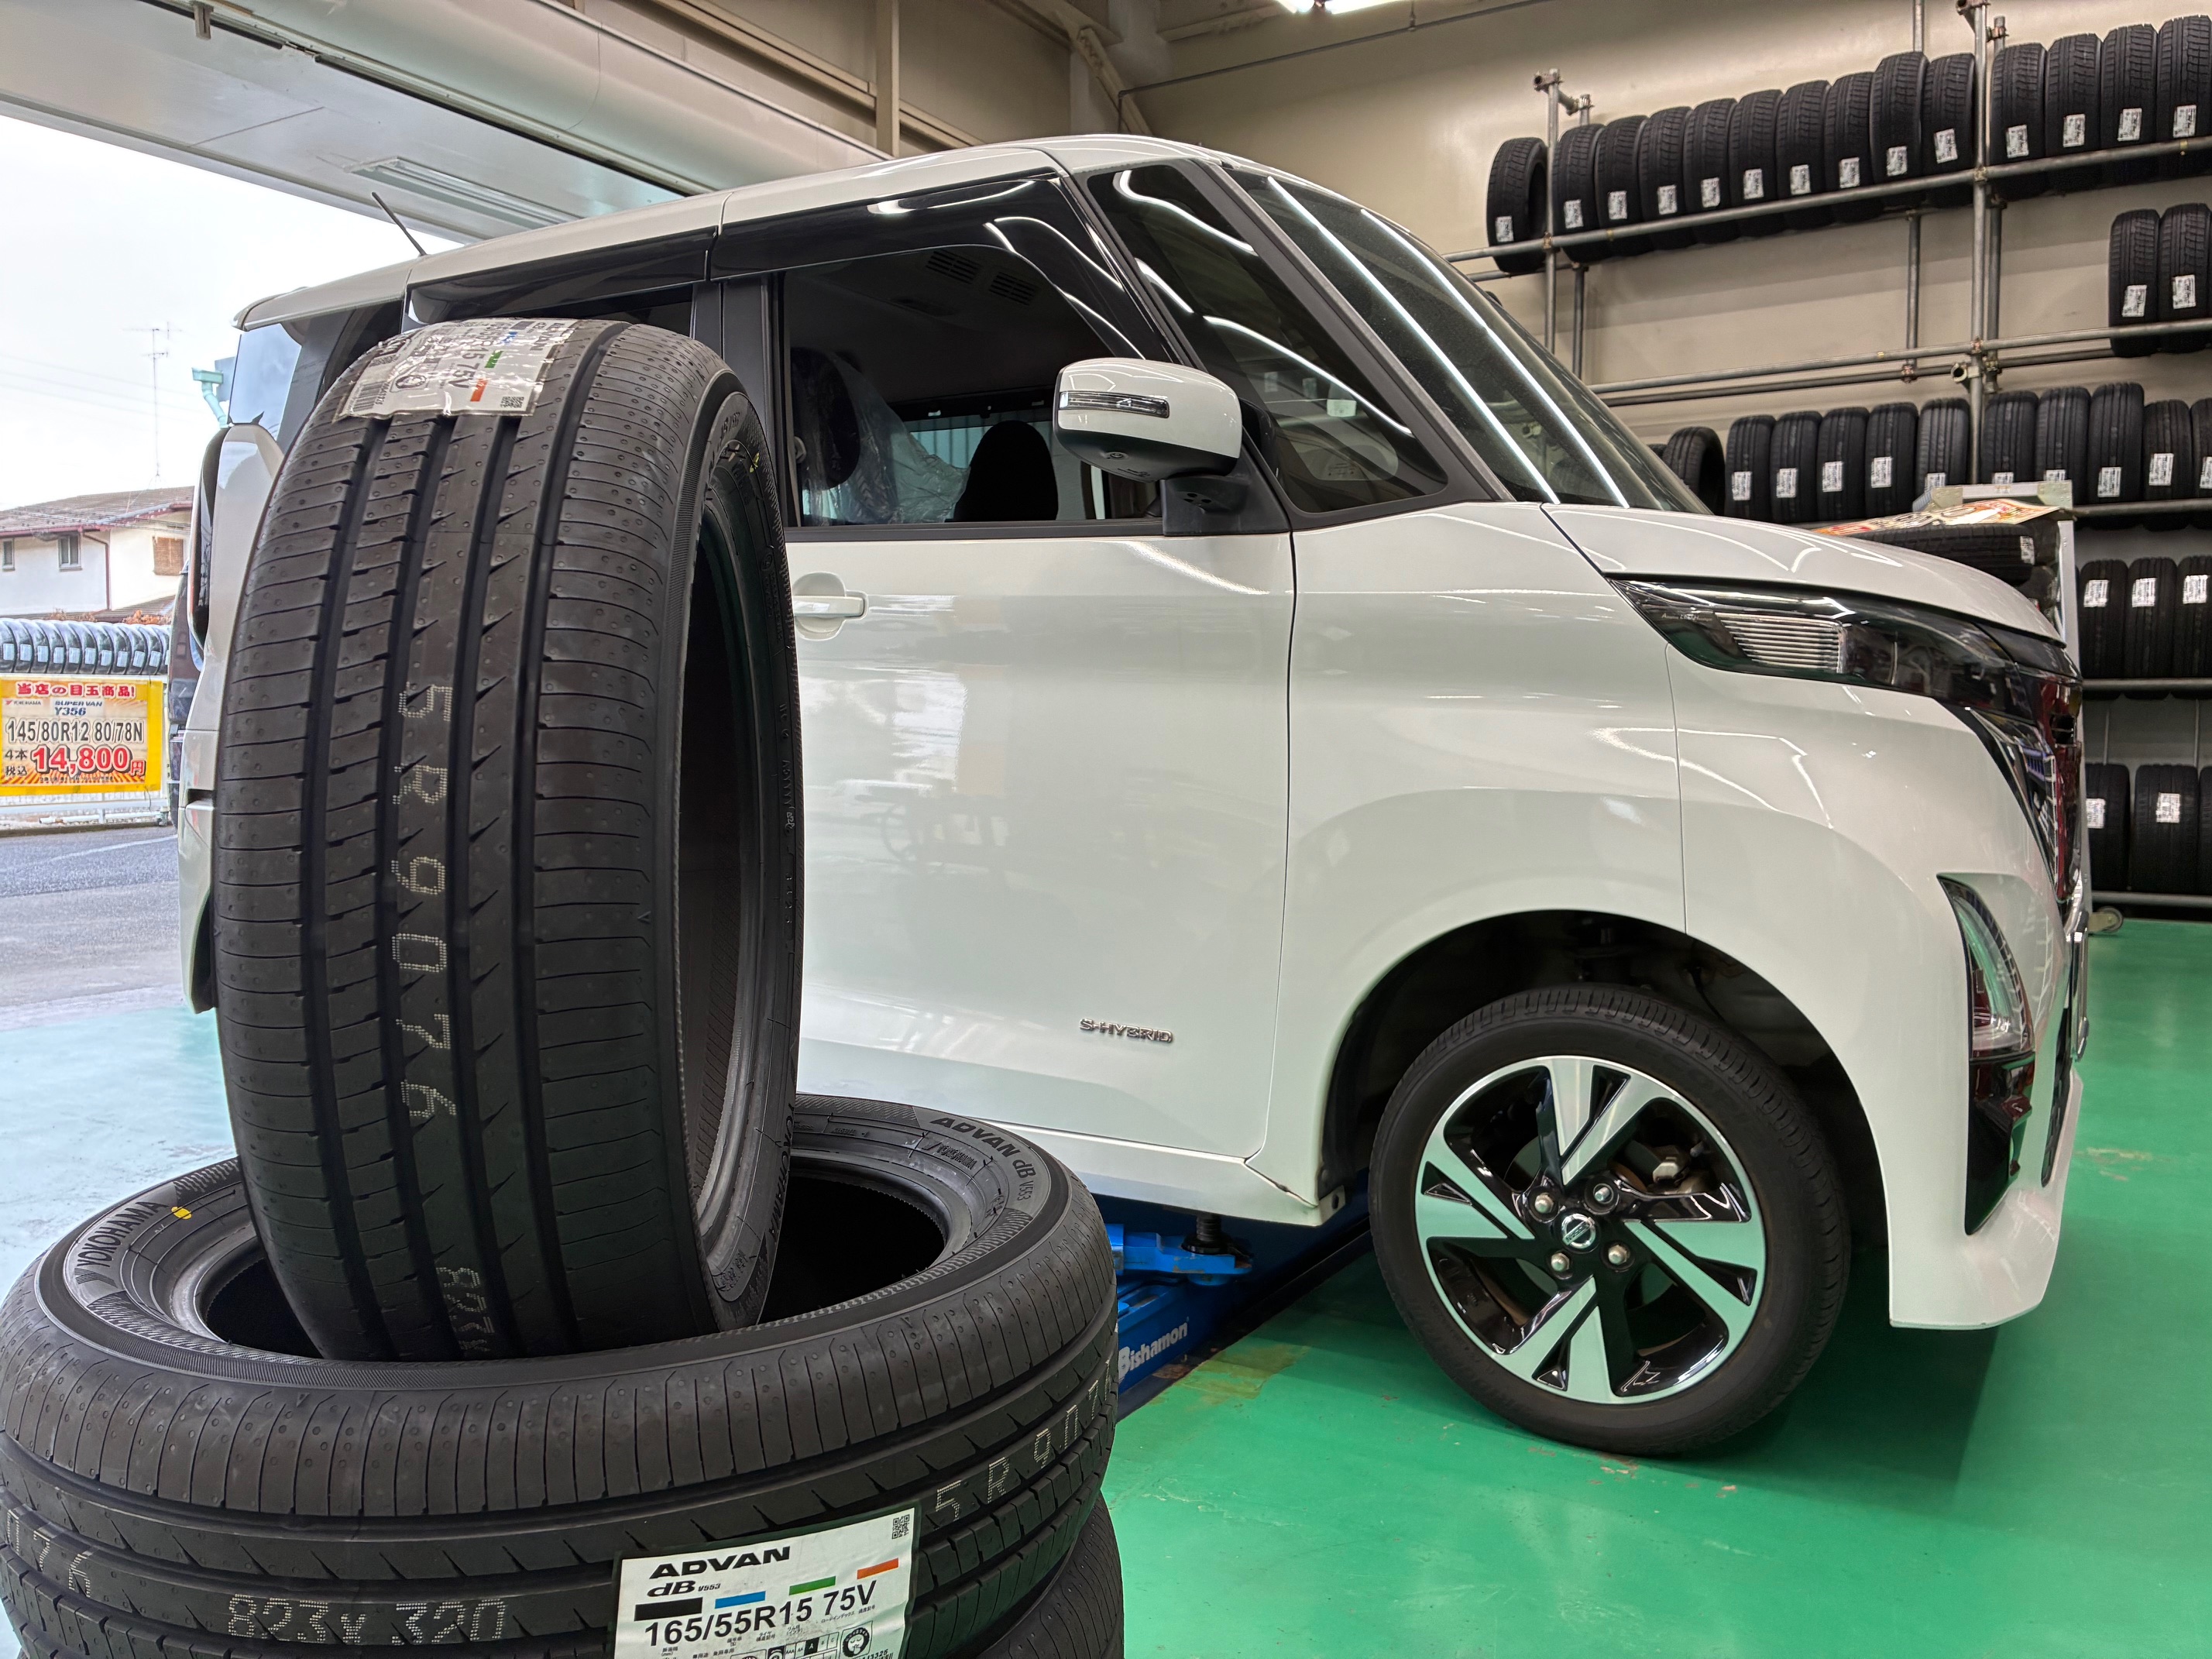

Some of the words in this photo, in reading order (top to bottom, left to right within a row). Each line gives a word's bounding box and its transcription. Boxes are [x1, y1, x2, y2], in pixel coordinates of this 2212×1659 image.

[17, 682, 136, 697] 当店の目玉商品!
[54, 706, 88, 716] Y356
[7, 720, 90, 743] 145/80R12
[94, 721, 143, 742] 80/78N
[4, 748, 28, 761] 4本
[5, 765, 28, 775] 税込
[1079, 1018, 1173, 1043] S-HYBRID
[929, 1118, 1021, 1158] ADVAN
[1012, 1159, 1036, 1179] dB
[77, 1201, 170, 1268] YOKOHAMA
[1117, 1322, 1189, 1381] Bishamon
[649, 1546, 791, 1580] ADVAN
[647, 1572, 696, 1598] dB
[698, 1583, 721, 1592] V553
[644, 1596, 813, 1647] 165/55R15
[823, 1580, 878, 1616] 75V
